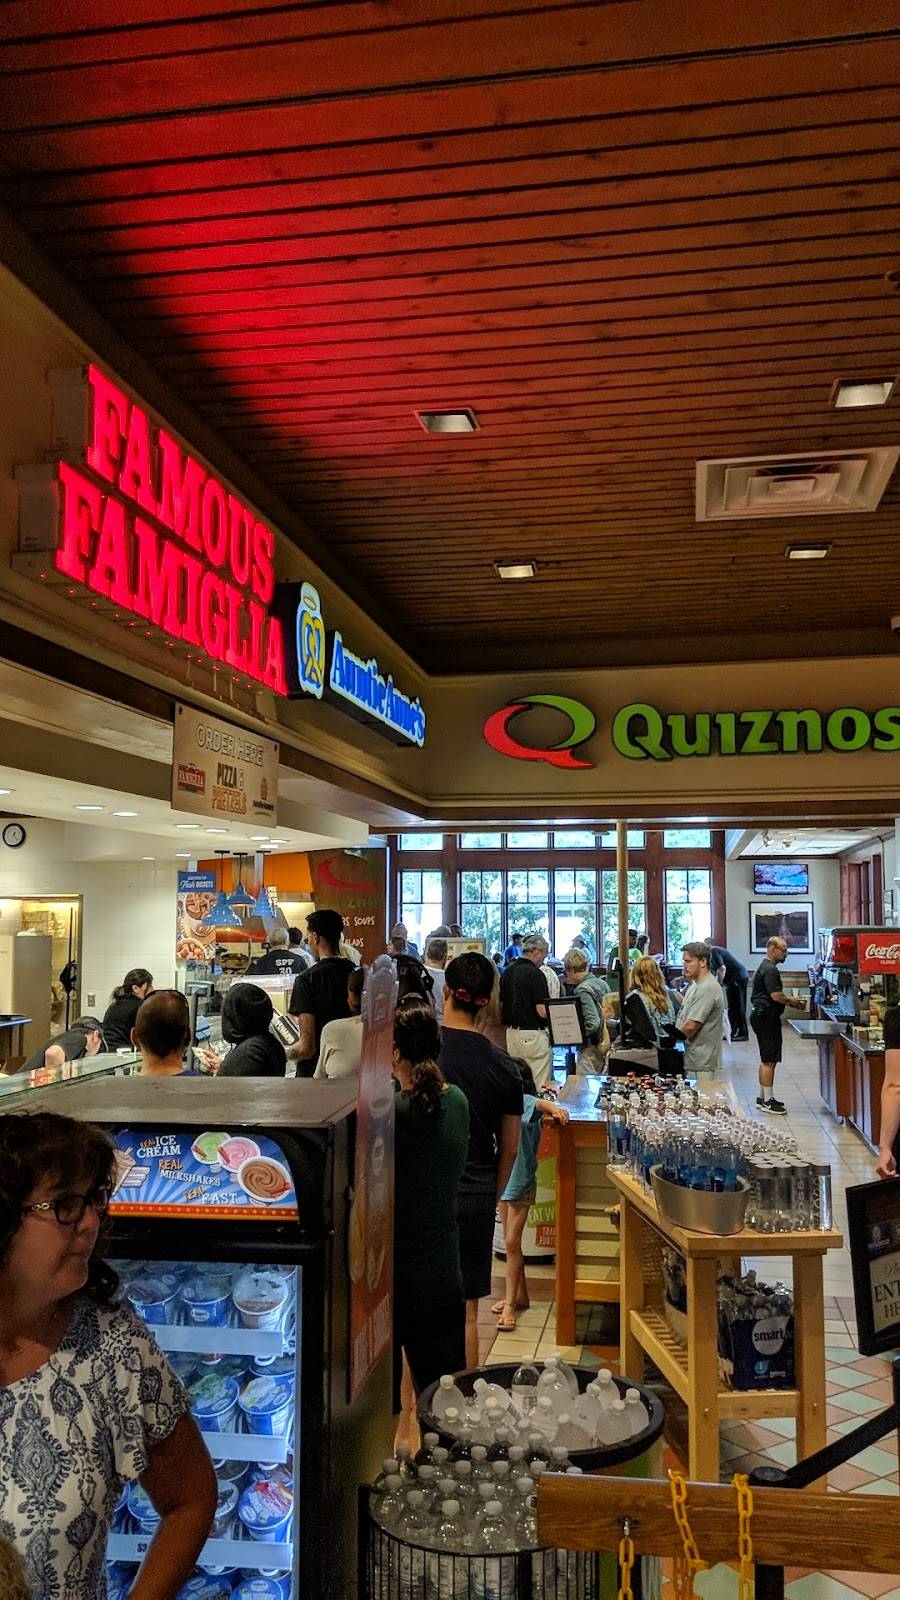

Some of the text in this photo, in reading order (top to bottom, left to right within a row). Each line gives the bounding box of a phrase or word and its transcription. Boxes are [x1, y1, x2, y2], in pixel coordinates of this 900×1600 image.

[86, 363, 274, 604] FAMOUS
[55, 460, 288, 696] FAMIGLIA
[331, 638, 425, 741] Auntie Anne's
[196, 723, 264, 768] ORDER HERE
[217, 762, 238, 789] PIZZA
[212, 785, 247, 816] PRETZELS
[354, 916, 376, 926] SOUPS
[155, 1135, 177, 1146] ICE
[137, 1144, 181, 1158] CREAM
[159, 1159, 183, 1170] REAL
[160, 1169, 221, 1187] MILKSHAKES
[202, 1192, 238, 1205] FAST
[528, 1206, 544, 1223] EAT
[753, 1328, 786, 1341] smart
